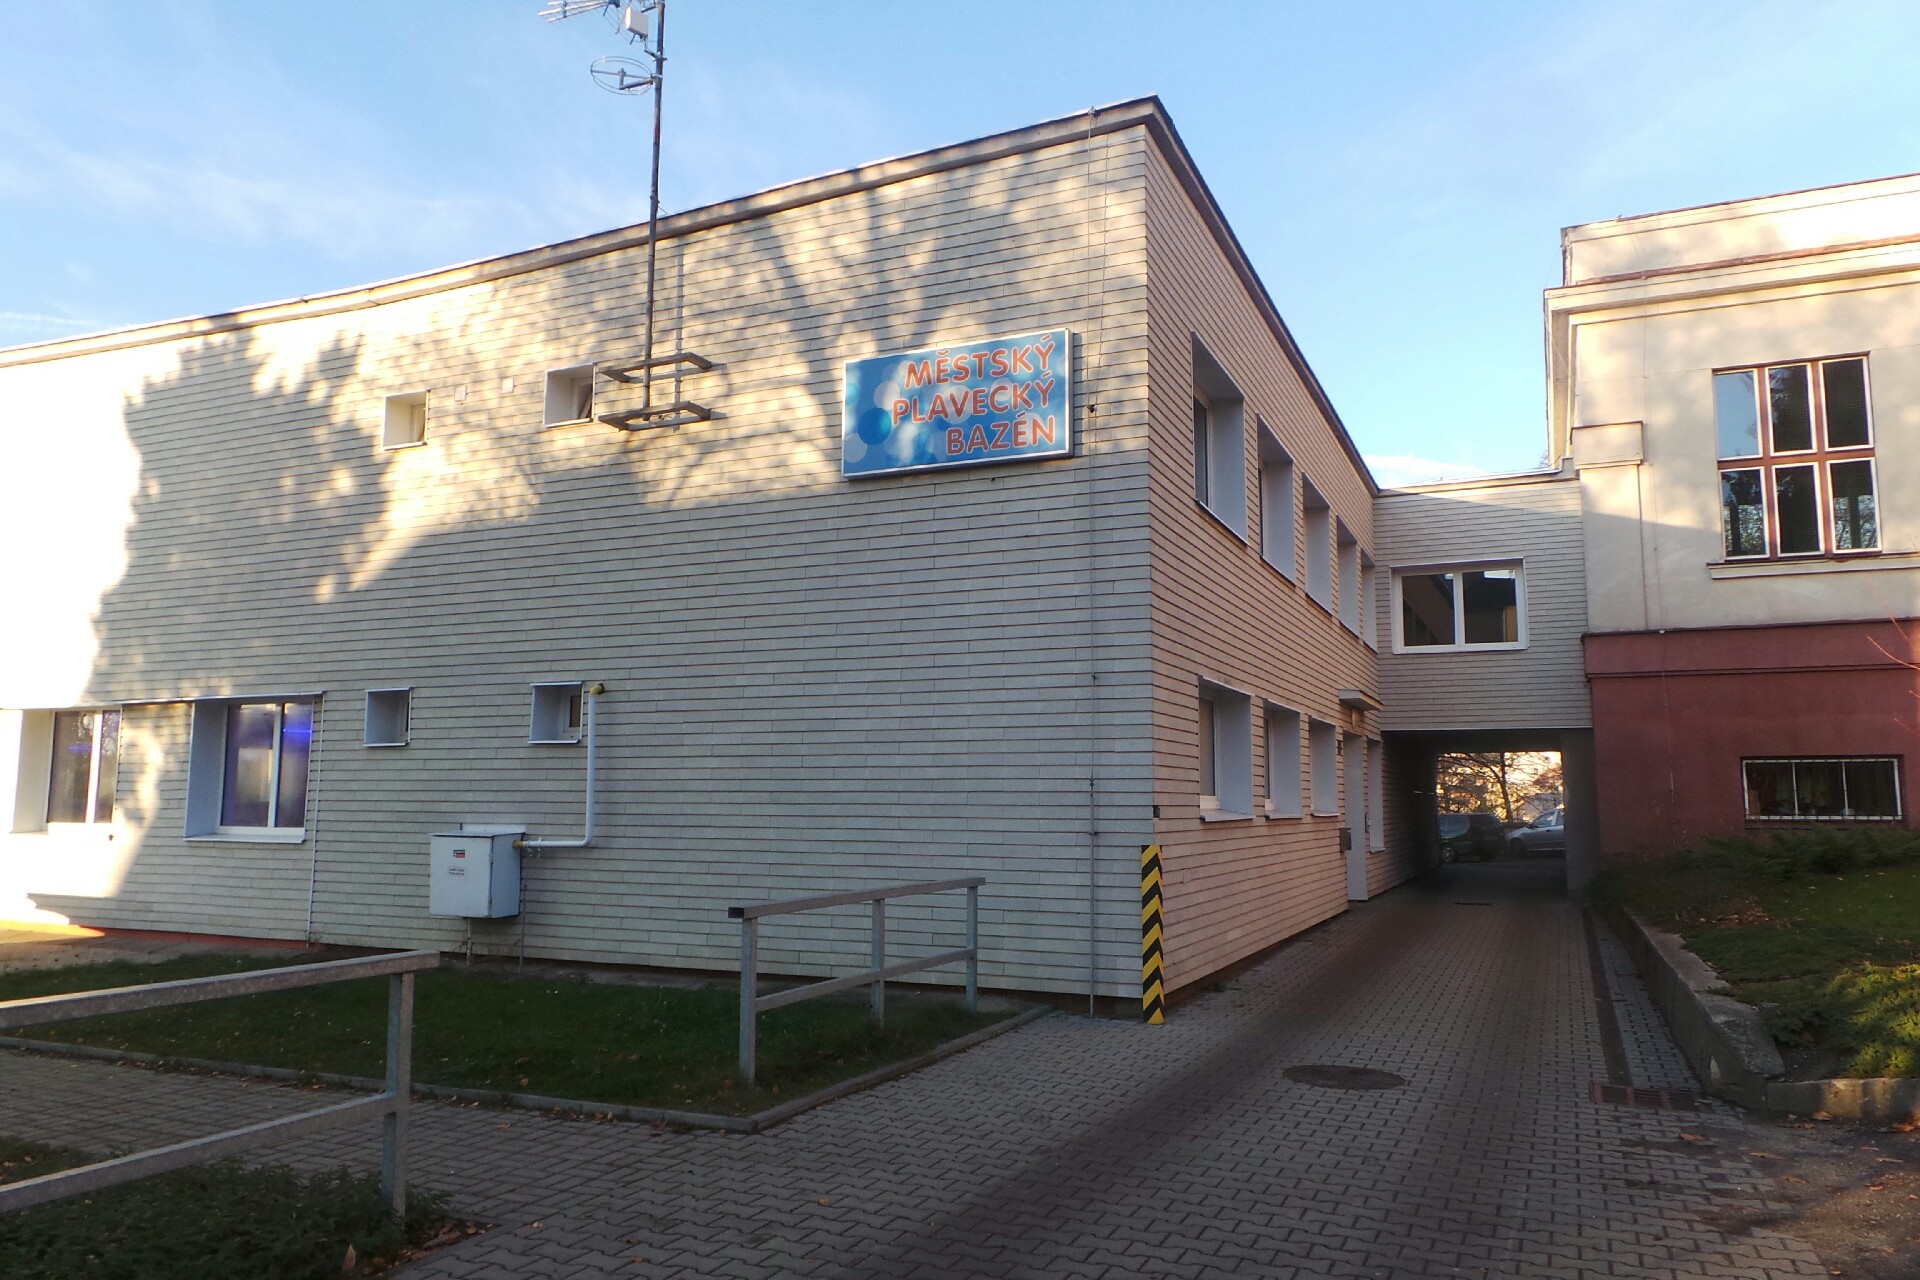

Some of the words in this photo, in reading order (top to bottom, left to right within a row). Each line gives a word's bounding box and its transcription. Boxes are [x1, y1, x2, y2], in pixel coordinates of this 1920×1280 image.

[904, 334, 1055, 389] MĚSTSKÝ
[892, 371, 1055, 425] PLAVECKÝ
[946, 412, 1055, 455] BAZÉN
